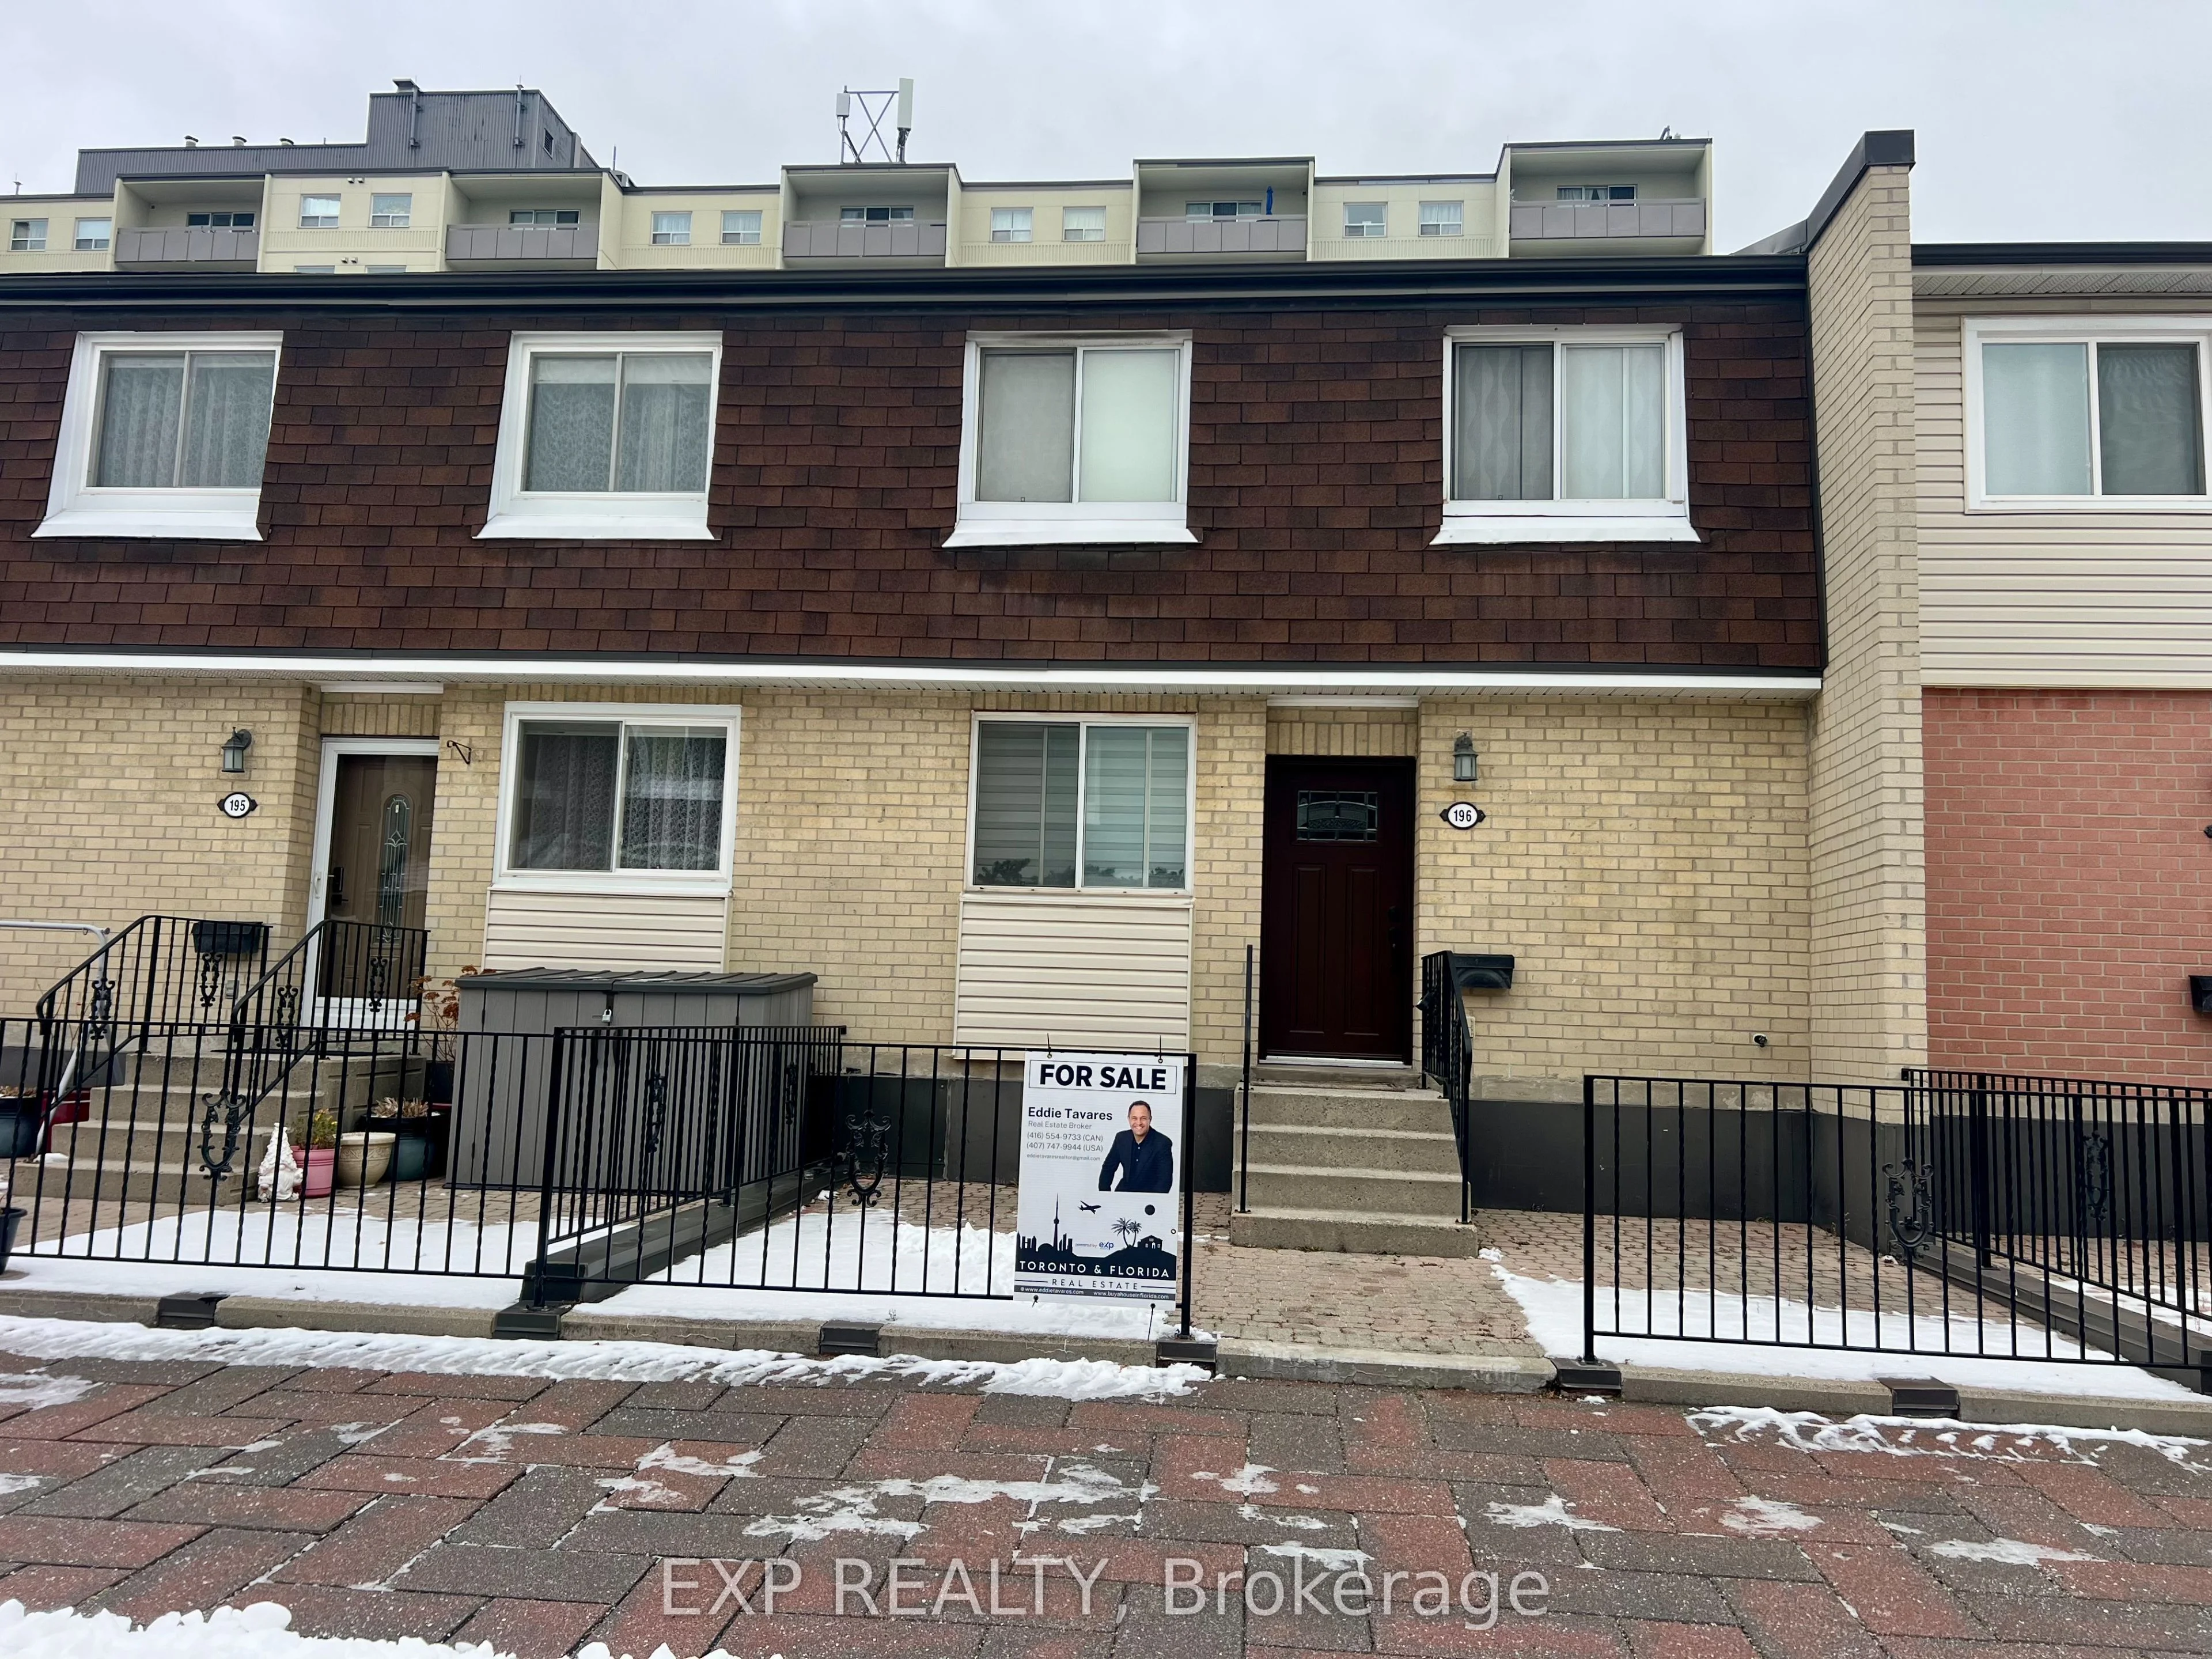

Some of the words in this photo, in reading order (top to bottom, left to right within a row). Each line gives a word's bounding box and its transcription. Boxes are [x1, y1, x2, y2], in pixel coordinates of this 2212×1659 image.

[229, 799, 246, 812] 195
[1453, 809, 1472, 822] 196
[1040, 1063, 1093, 1086] FOR
[1099, 1066, 1166, 1090] SALE
[1028, 1107, 1062, 1118] Eddie
[1065, 1108, 1113, 1120] Tavares
[1046, 1132, 1081, 1141] 554-9733
[1083, 1134, 1103, 1142] (CAN)
[1083, 1144, 1103, 1152] (USA)
[1019, 1260, 1086, 1273] TORONTO
[1094, 1264, 1101, 1274] &
[1109, 1265, 1169, 1278] FLORIDA
[1052, 1278, 1083, 1287] REAL
[1092, 1281, 1138, 1290] ESTATE
[1025, 1287, 1084, 1295] www.eddietavares.com
[1093, 1290, 1169, 1300] www.buyahouseinflorida.com
